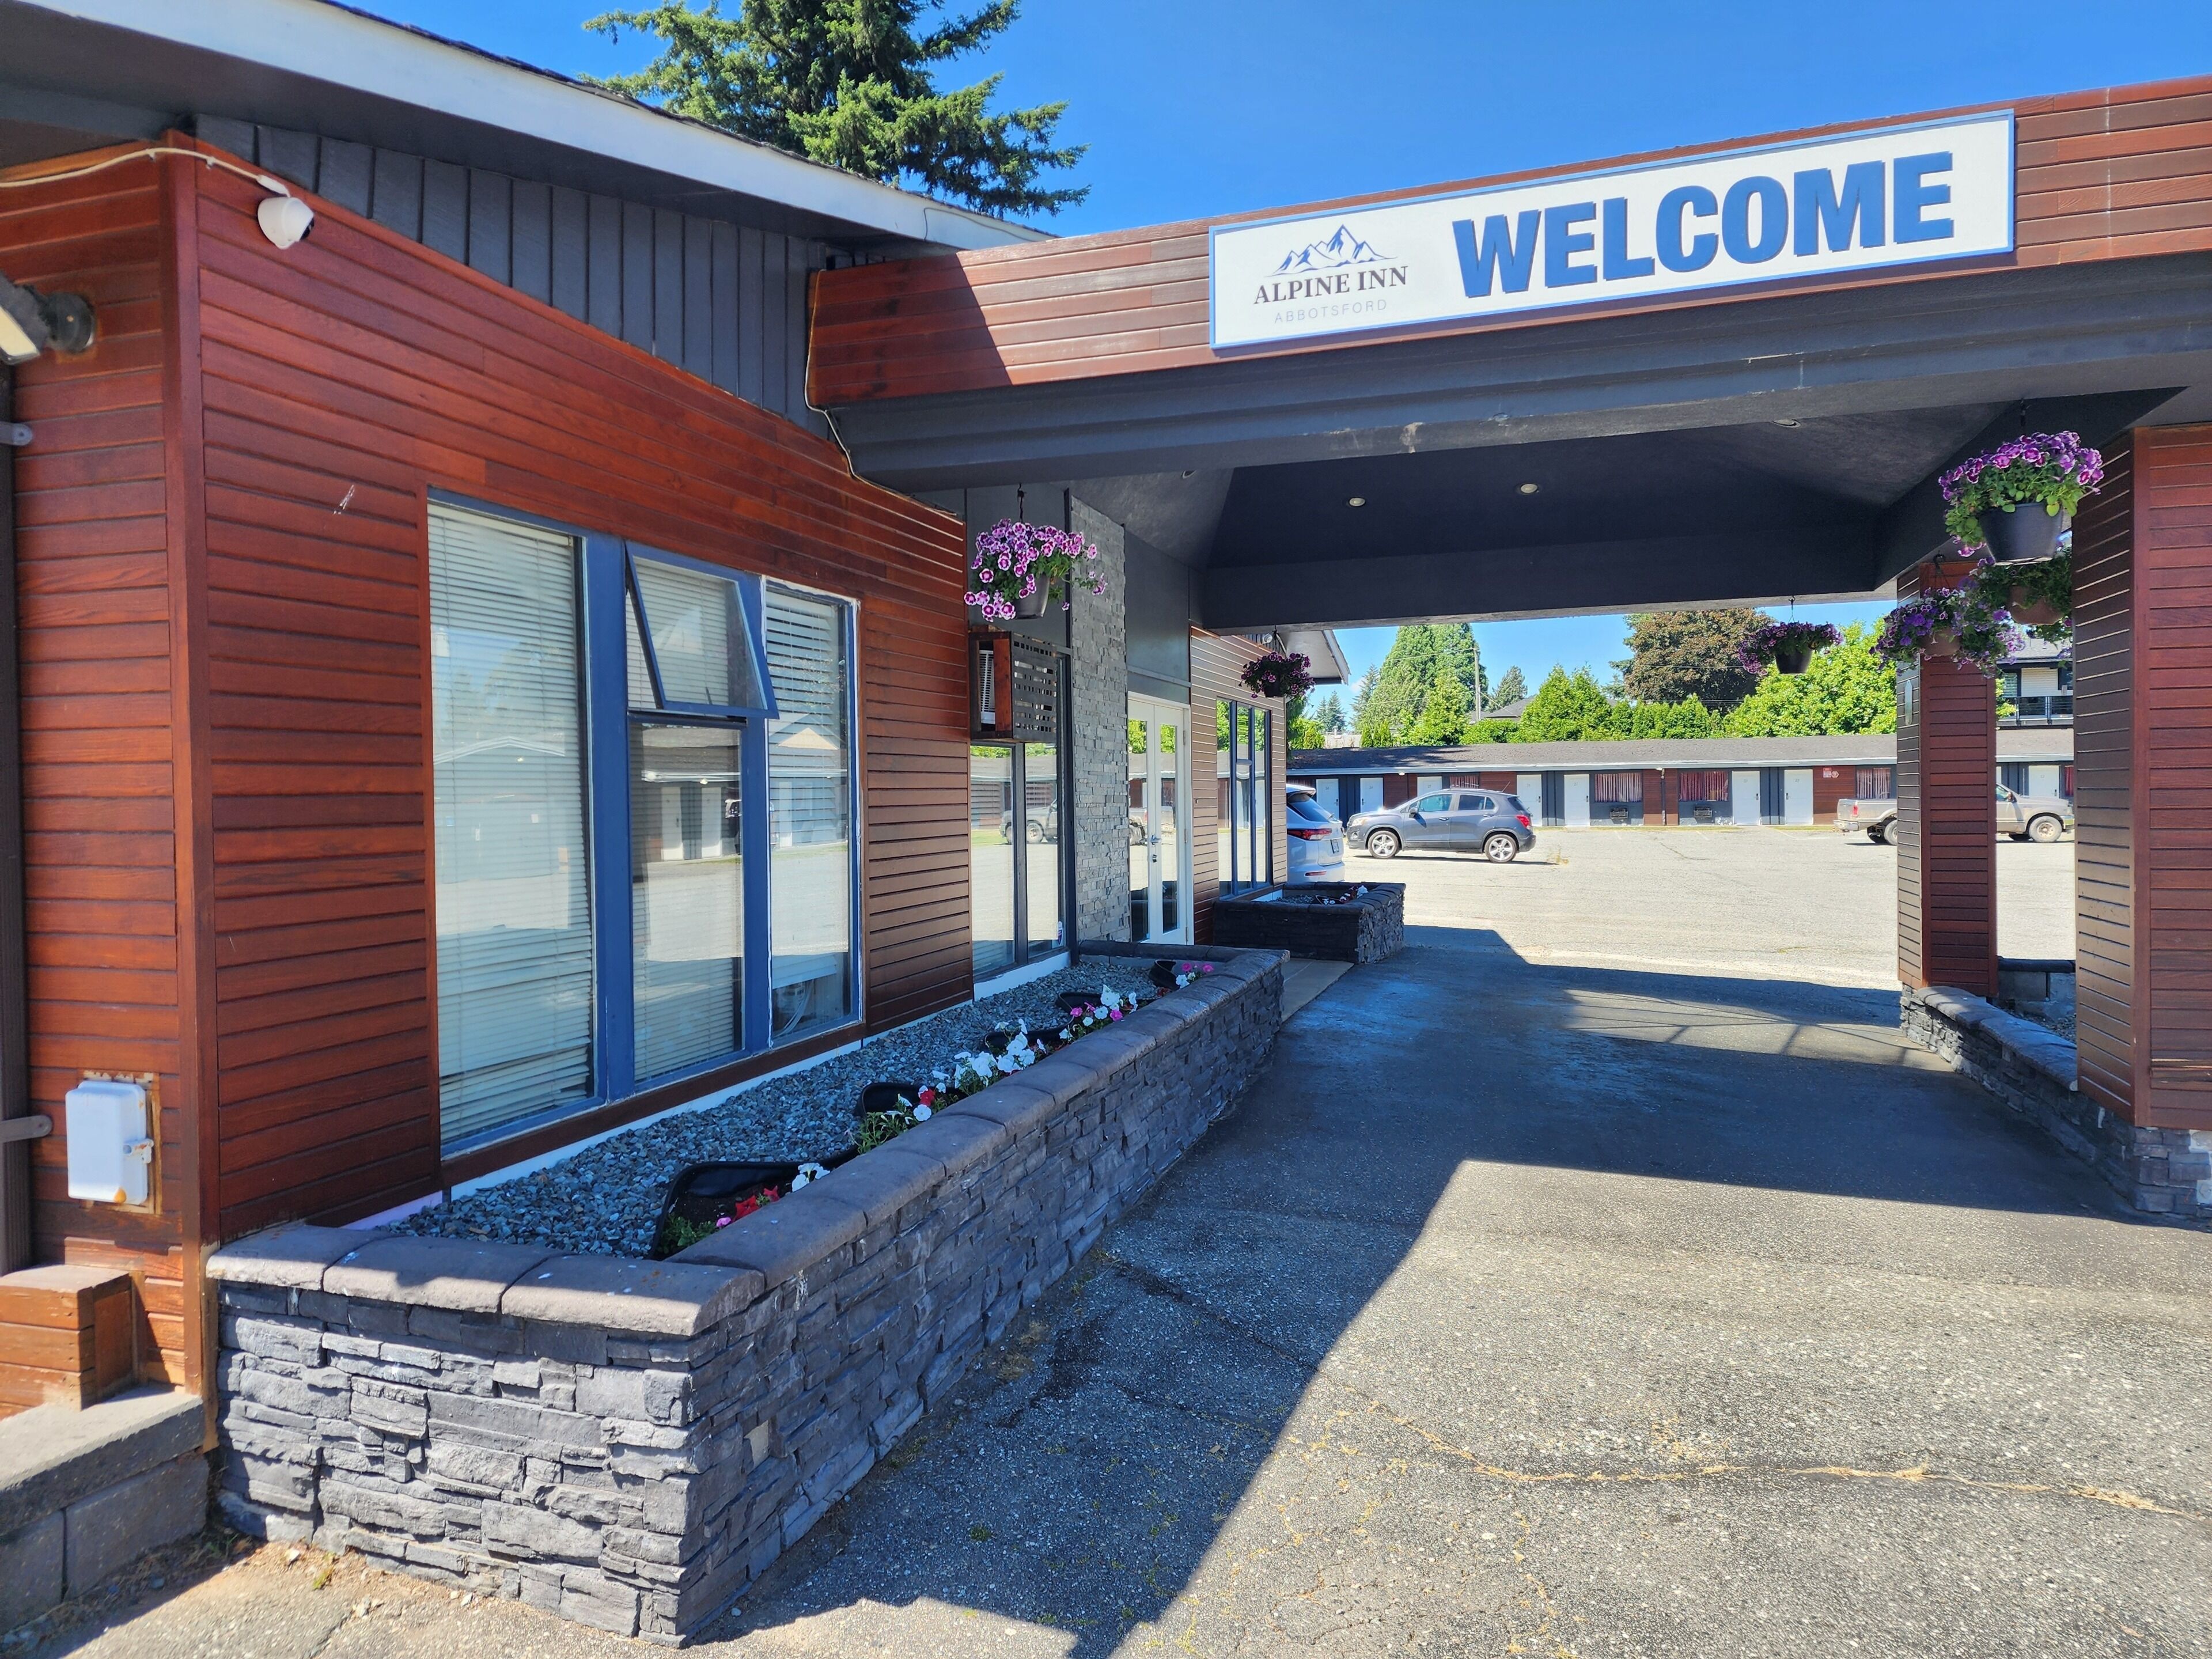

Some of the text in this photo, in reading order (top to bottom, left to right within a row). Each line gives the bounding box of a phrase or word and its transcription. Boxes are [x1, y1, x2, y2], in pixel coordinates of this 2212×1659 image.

[1452, 150, 1955, 298] WELCOME
[1253, 266, 1408, 304] ALPINE INN
[1274, 299, 1387, 324] ABBOTSFORD
